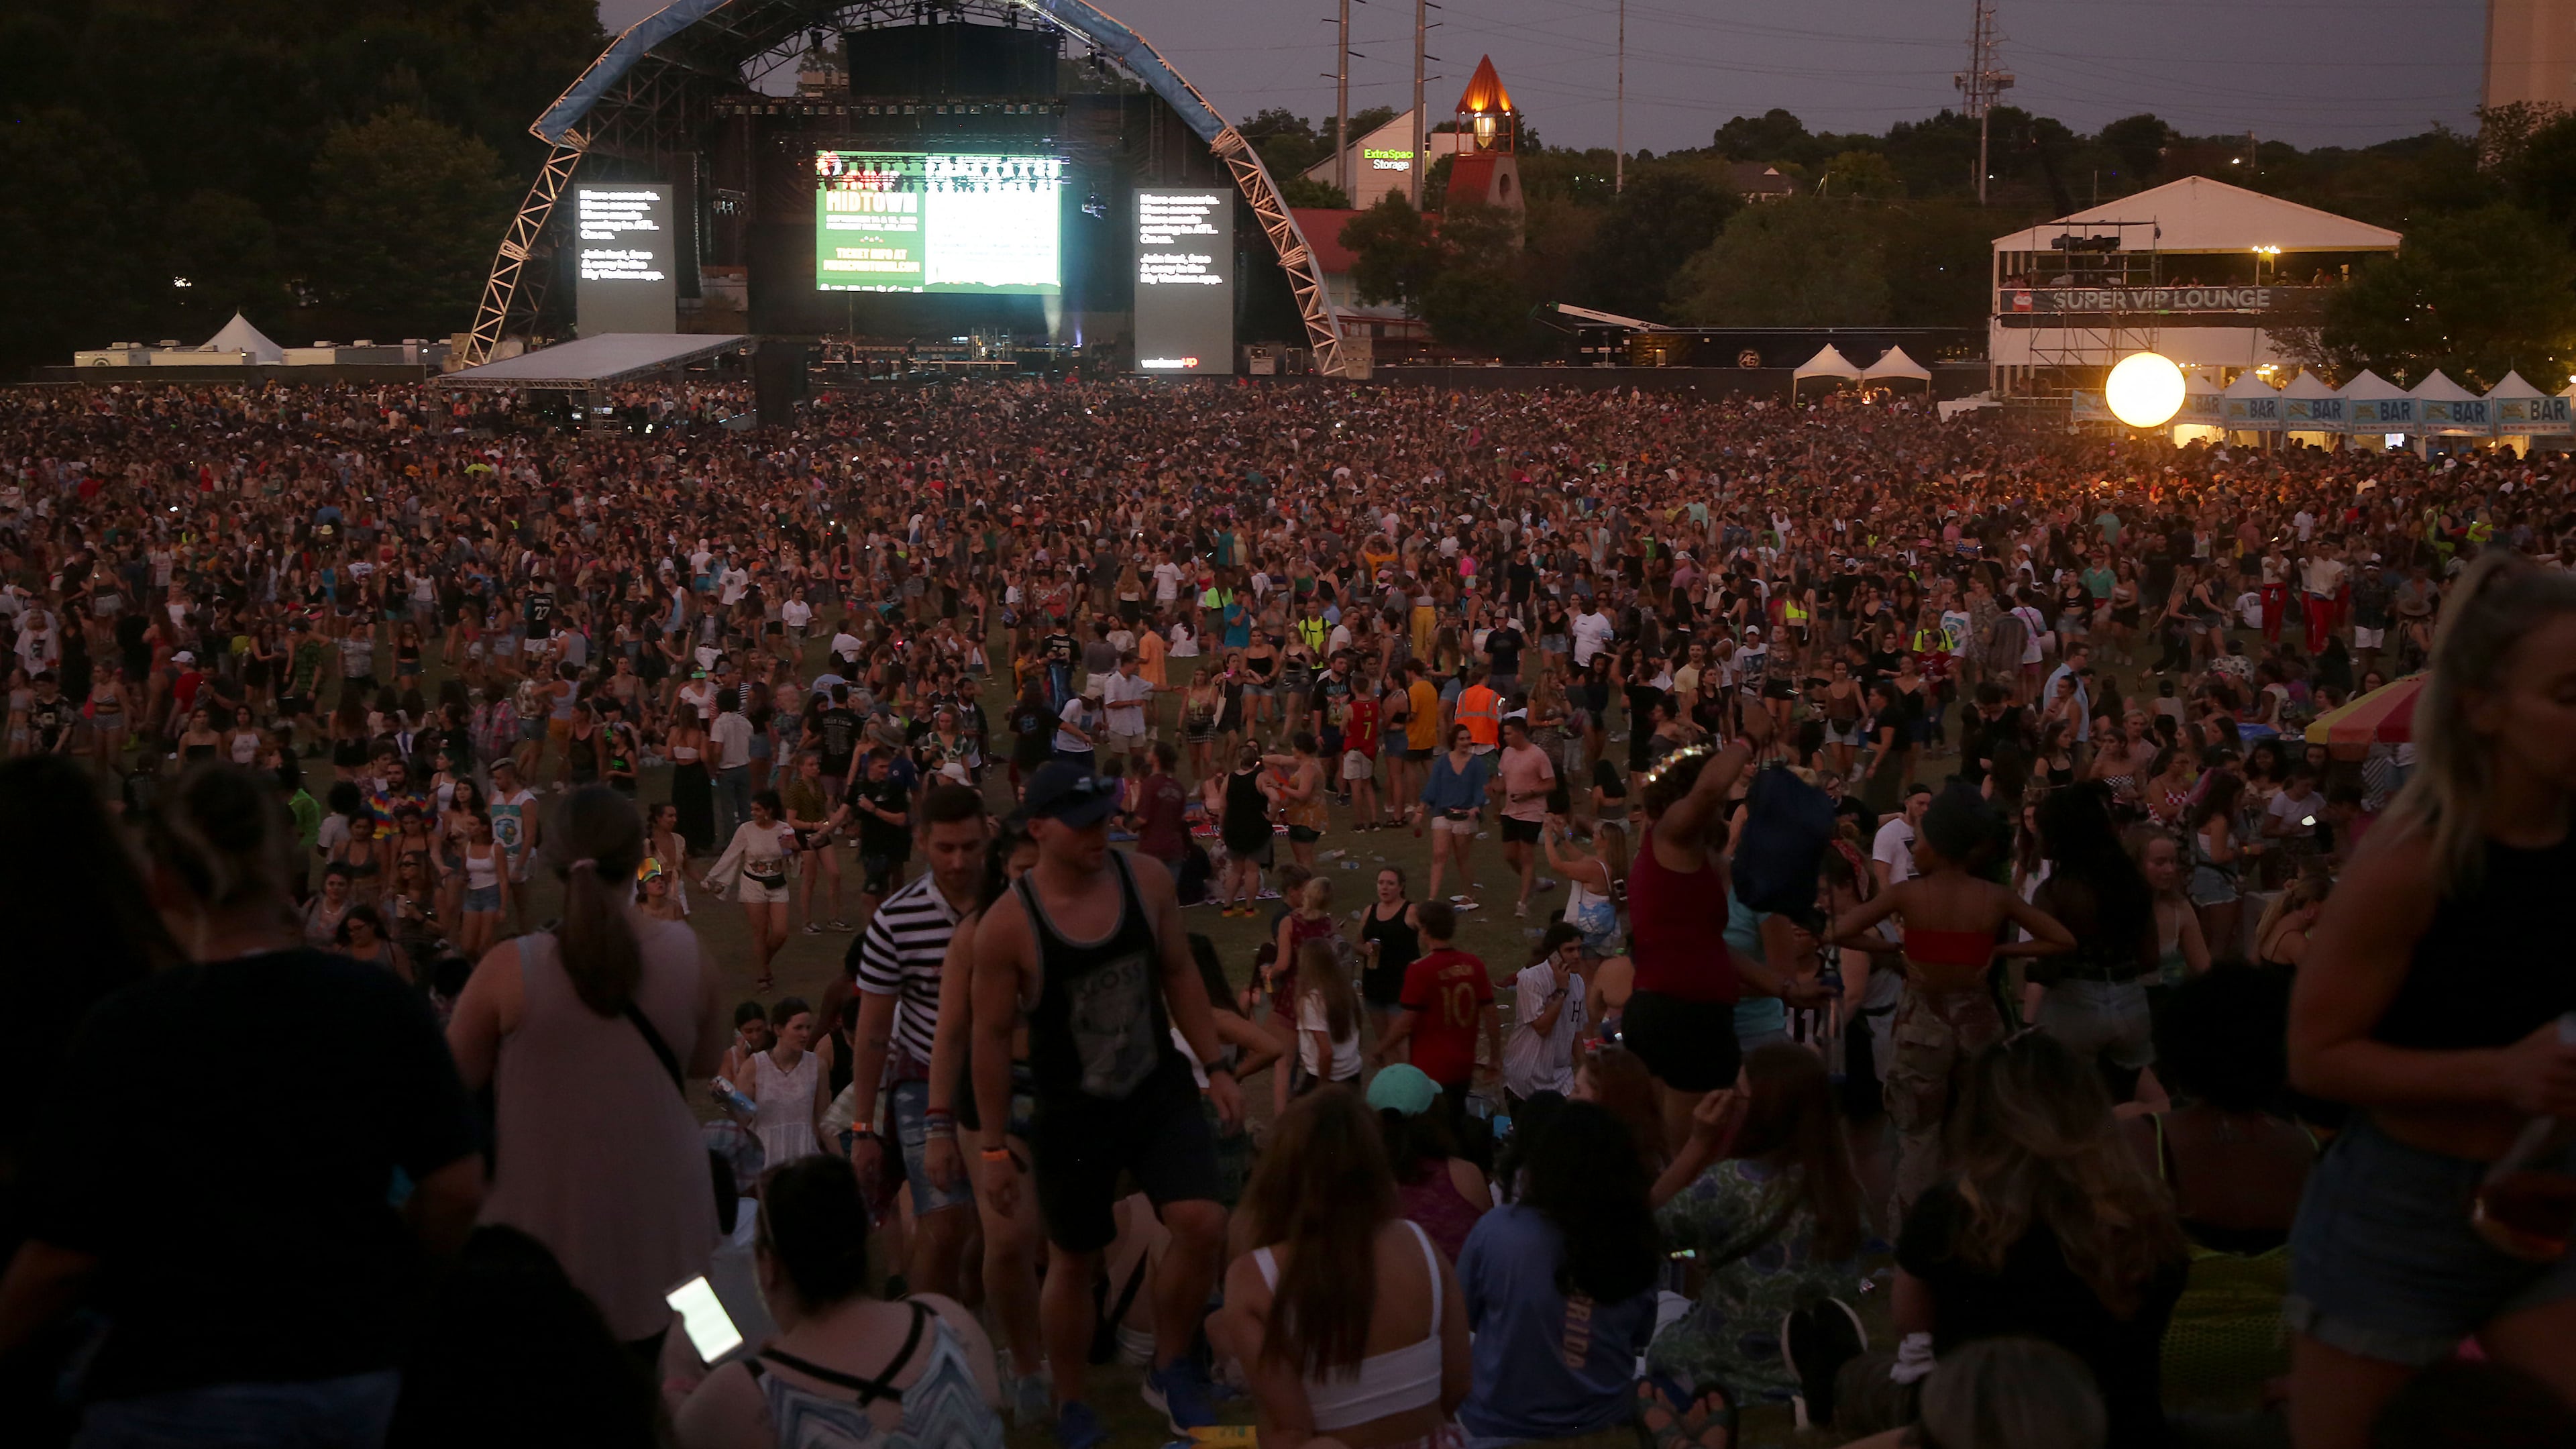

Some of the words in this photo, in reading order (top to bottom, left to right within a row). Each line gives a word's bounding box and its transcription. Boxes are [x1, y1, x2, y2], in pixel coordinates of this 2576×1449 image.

[1373, 159, 1409, 171] Storage
[826, 191, 918, 213] MIDTOWN
[836, 248, 869, 260] TICKET
[894, 249, 907, 260] AT
[2053, 290, 2127, 310] SUPER
[2131, 290, 2169, 309] VIP
[2174, 288, 2271, 308] LOUNGE
[2195, 395, 2220, 414] BAR
[2250, 400, 2275, 418] BAR
[2312, 400, 2341, 419] BAR
[2381, 402, 2410, 421] BAR
[2453, 402, 2485, 423] BAR
[2530, 400, 2565, 421] BAR
[534, 606, 550, 621] 27
[1439, 981, 1477, 1030] 10
[1562, 1293, 1594, 1369] RIDA
